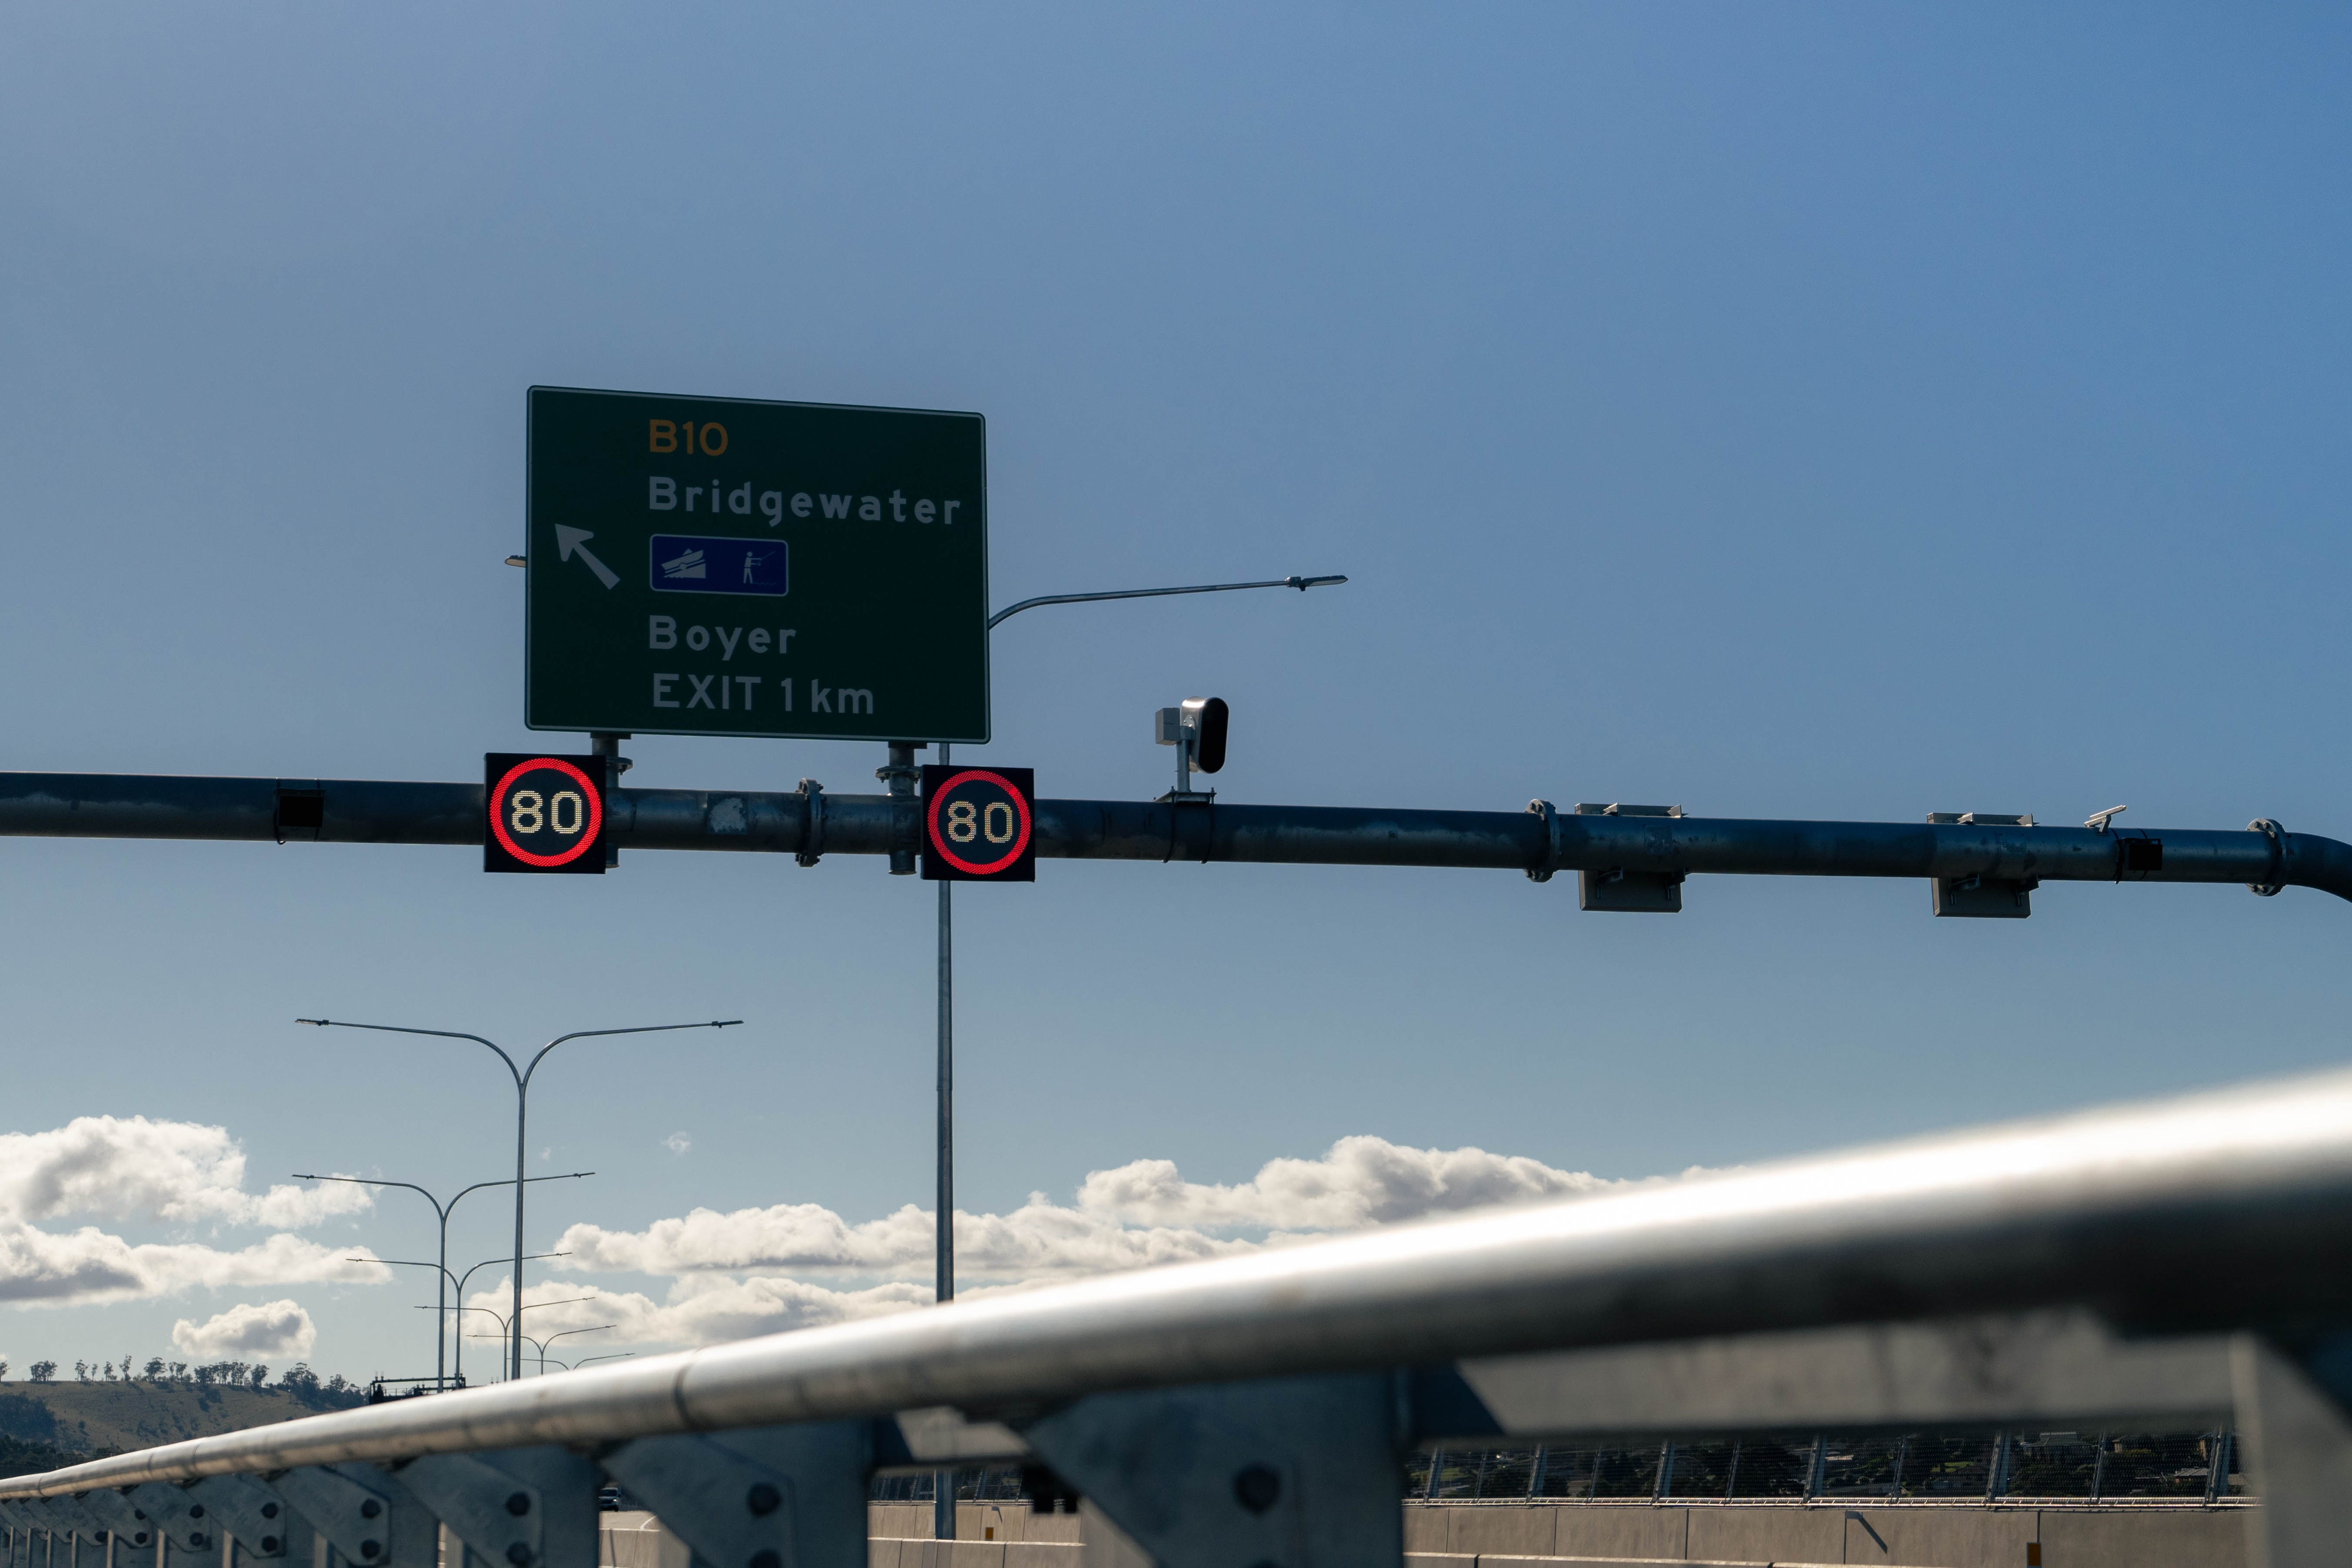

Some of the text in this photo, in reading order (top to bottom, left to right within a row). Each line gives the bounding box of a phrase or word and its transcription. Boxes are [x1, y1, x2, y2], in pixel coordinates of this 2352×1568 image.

[649, 419, 729, 457] B10
[649, 475, 961, 527] Bridgewater
[649, 614, 796, 661] Boyer
[653, 673, 874, 714] EXIT 1 km
[511, 791, 582, 834] 80
[948, 801, 1012, 843] 80
